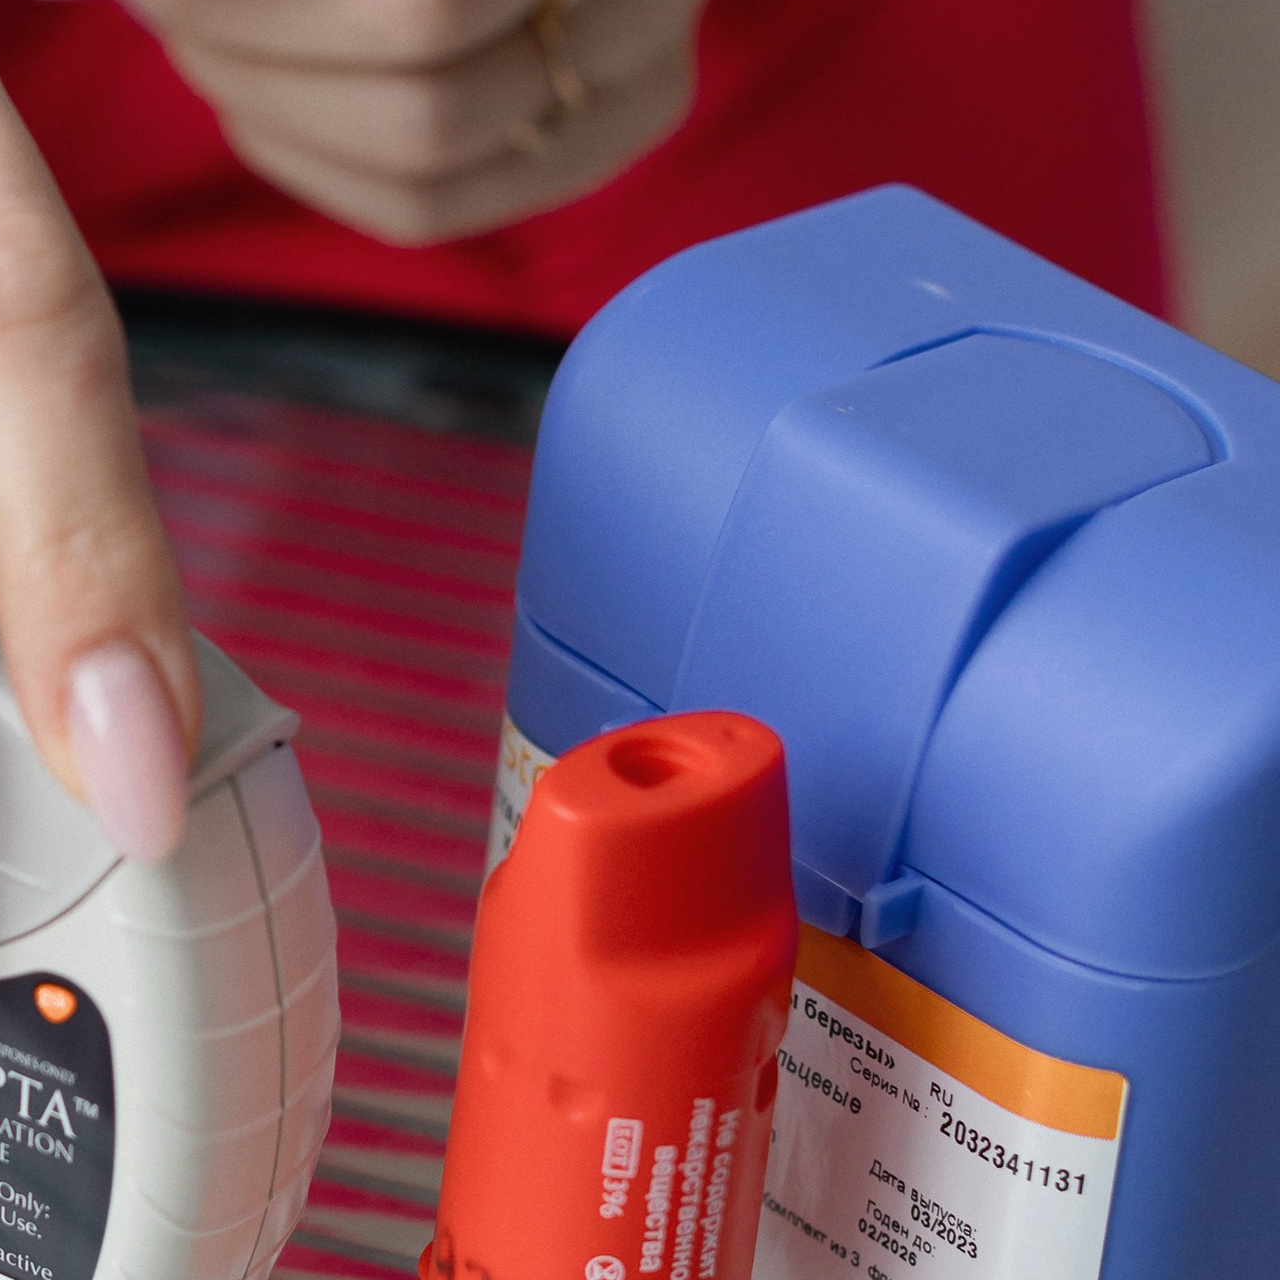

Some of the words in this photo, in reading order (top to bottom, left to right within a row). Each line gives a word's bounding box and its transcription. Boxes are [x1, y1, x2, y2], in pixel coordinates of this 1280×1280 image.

[804, 998, 896, 1070] березы»
[850, 1056, 899, 1099] Серия
[929, 1081, 954, 1108] RU
[939, 1111, 1086, 1195] 2032341131
[0, 1205, 42, 1239] Use.
[639, 1145, 678, 1273] вещества
[869, 1159, 906, 1194] Дата
[910, 1188, 977, 1240] выпуска:
[830, 1239, 847, 1260] из
[850, 1250, 861, 1267] 3
[857, 1218, 917, 1267] 02/2026
[865, 1198, 909, 1239] Годен
[912, 1235, 936, 1258] до:
[910, 1204, 978, 1259] 03/2023
